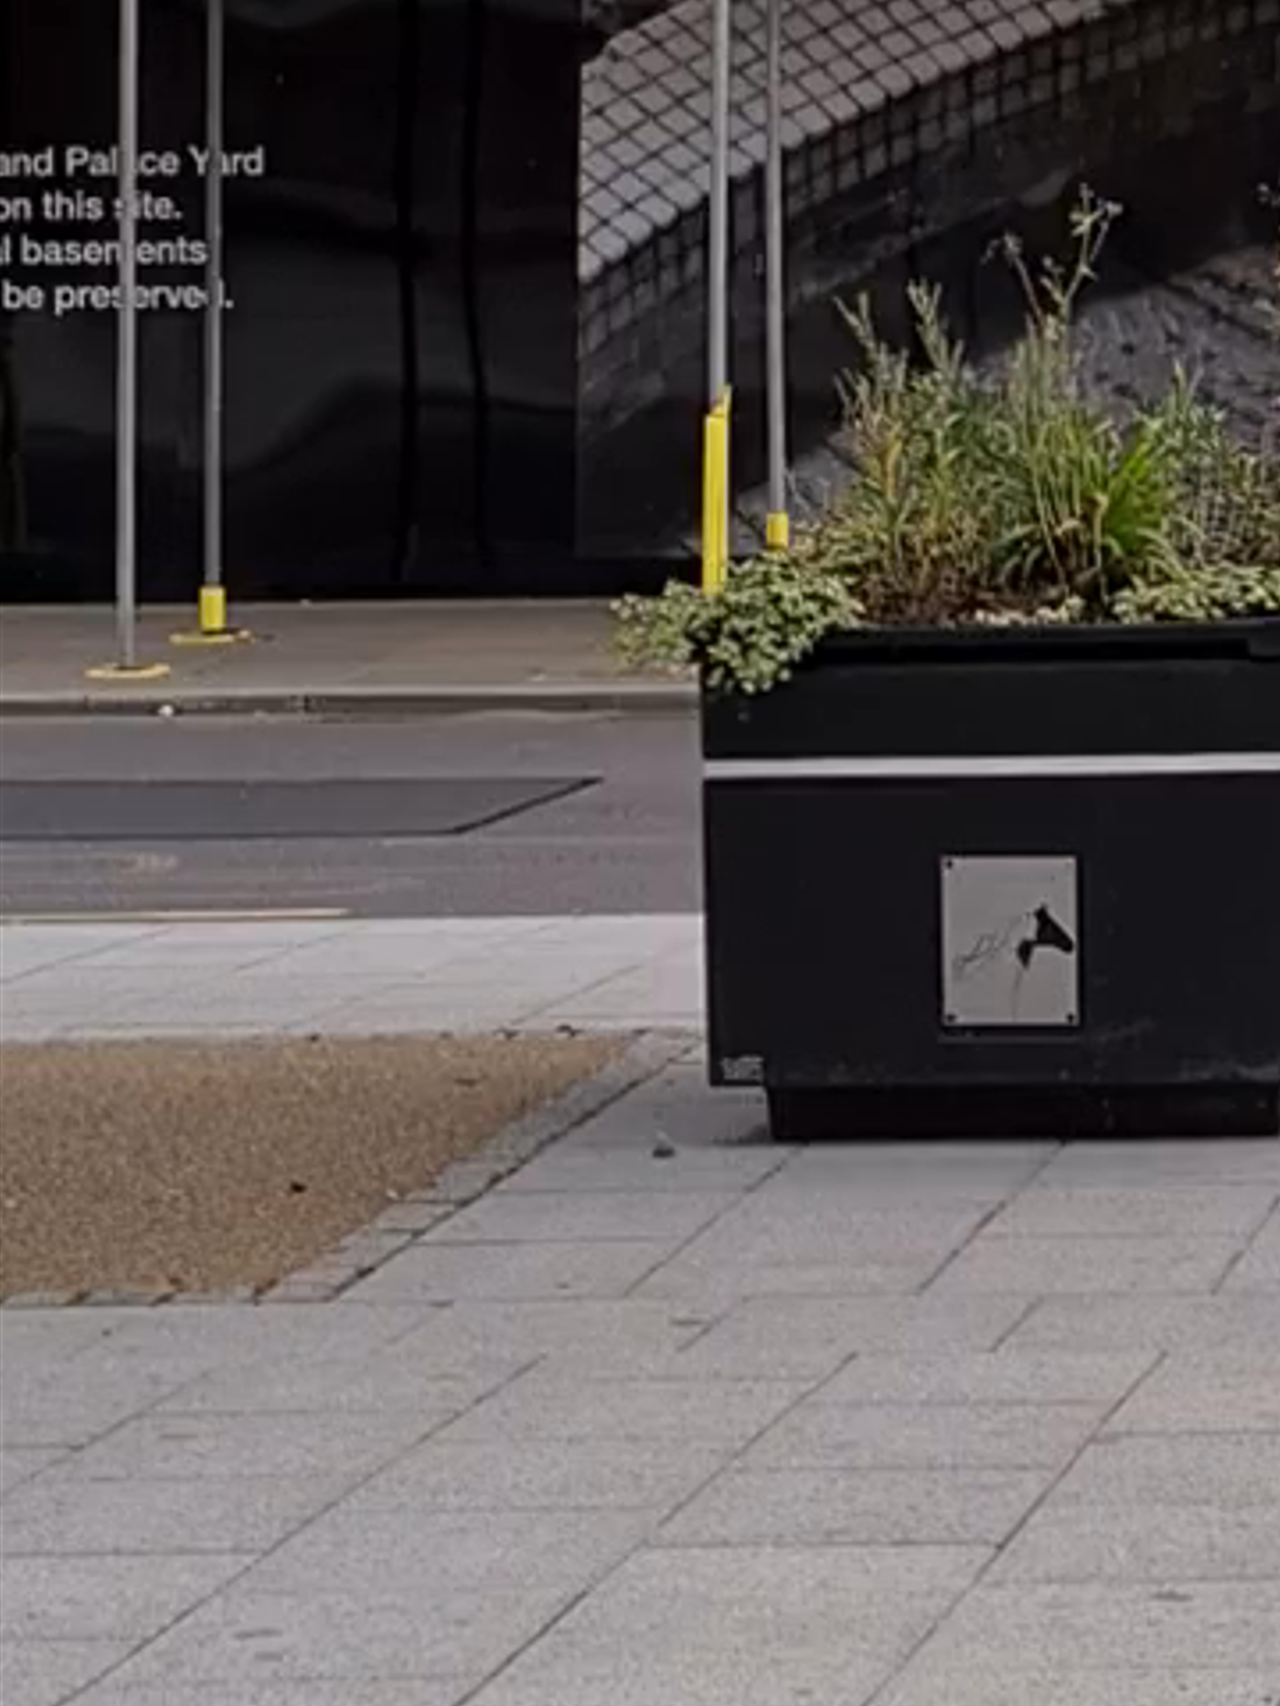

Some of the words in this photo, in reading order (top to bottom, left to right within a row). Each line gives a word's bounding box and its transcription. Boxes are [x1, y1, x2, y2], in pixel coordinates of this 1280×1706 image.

[65, 145, 182, 178] Palce
[42, 189, 104, 222] this
[2, 279, 45, 310] be
